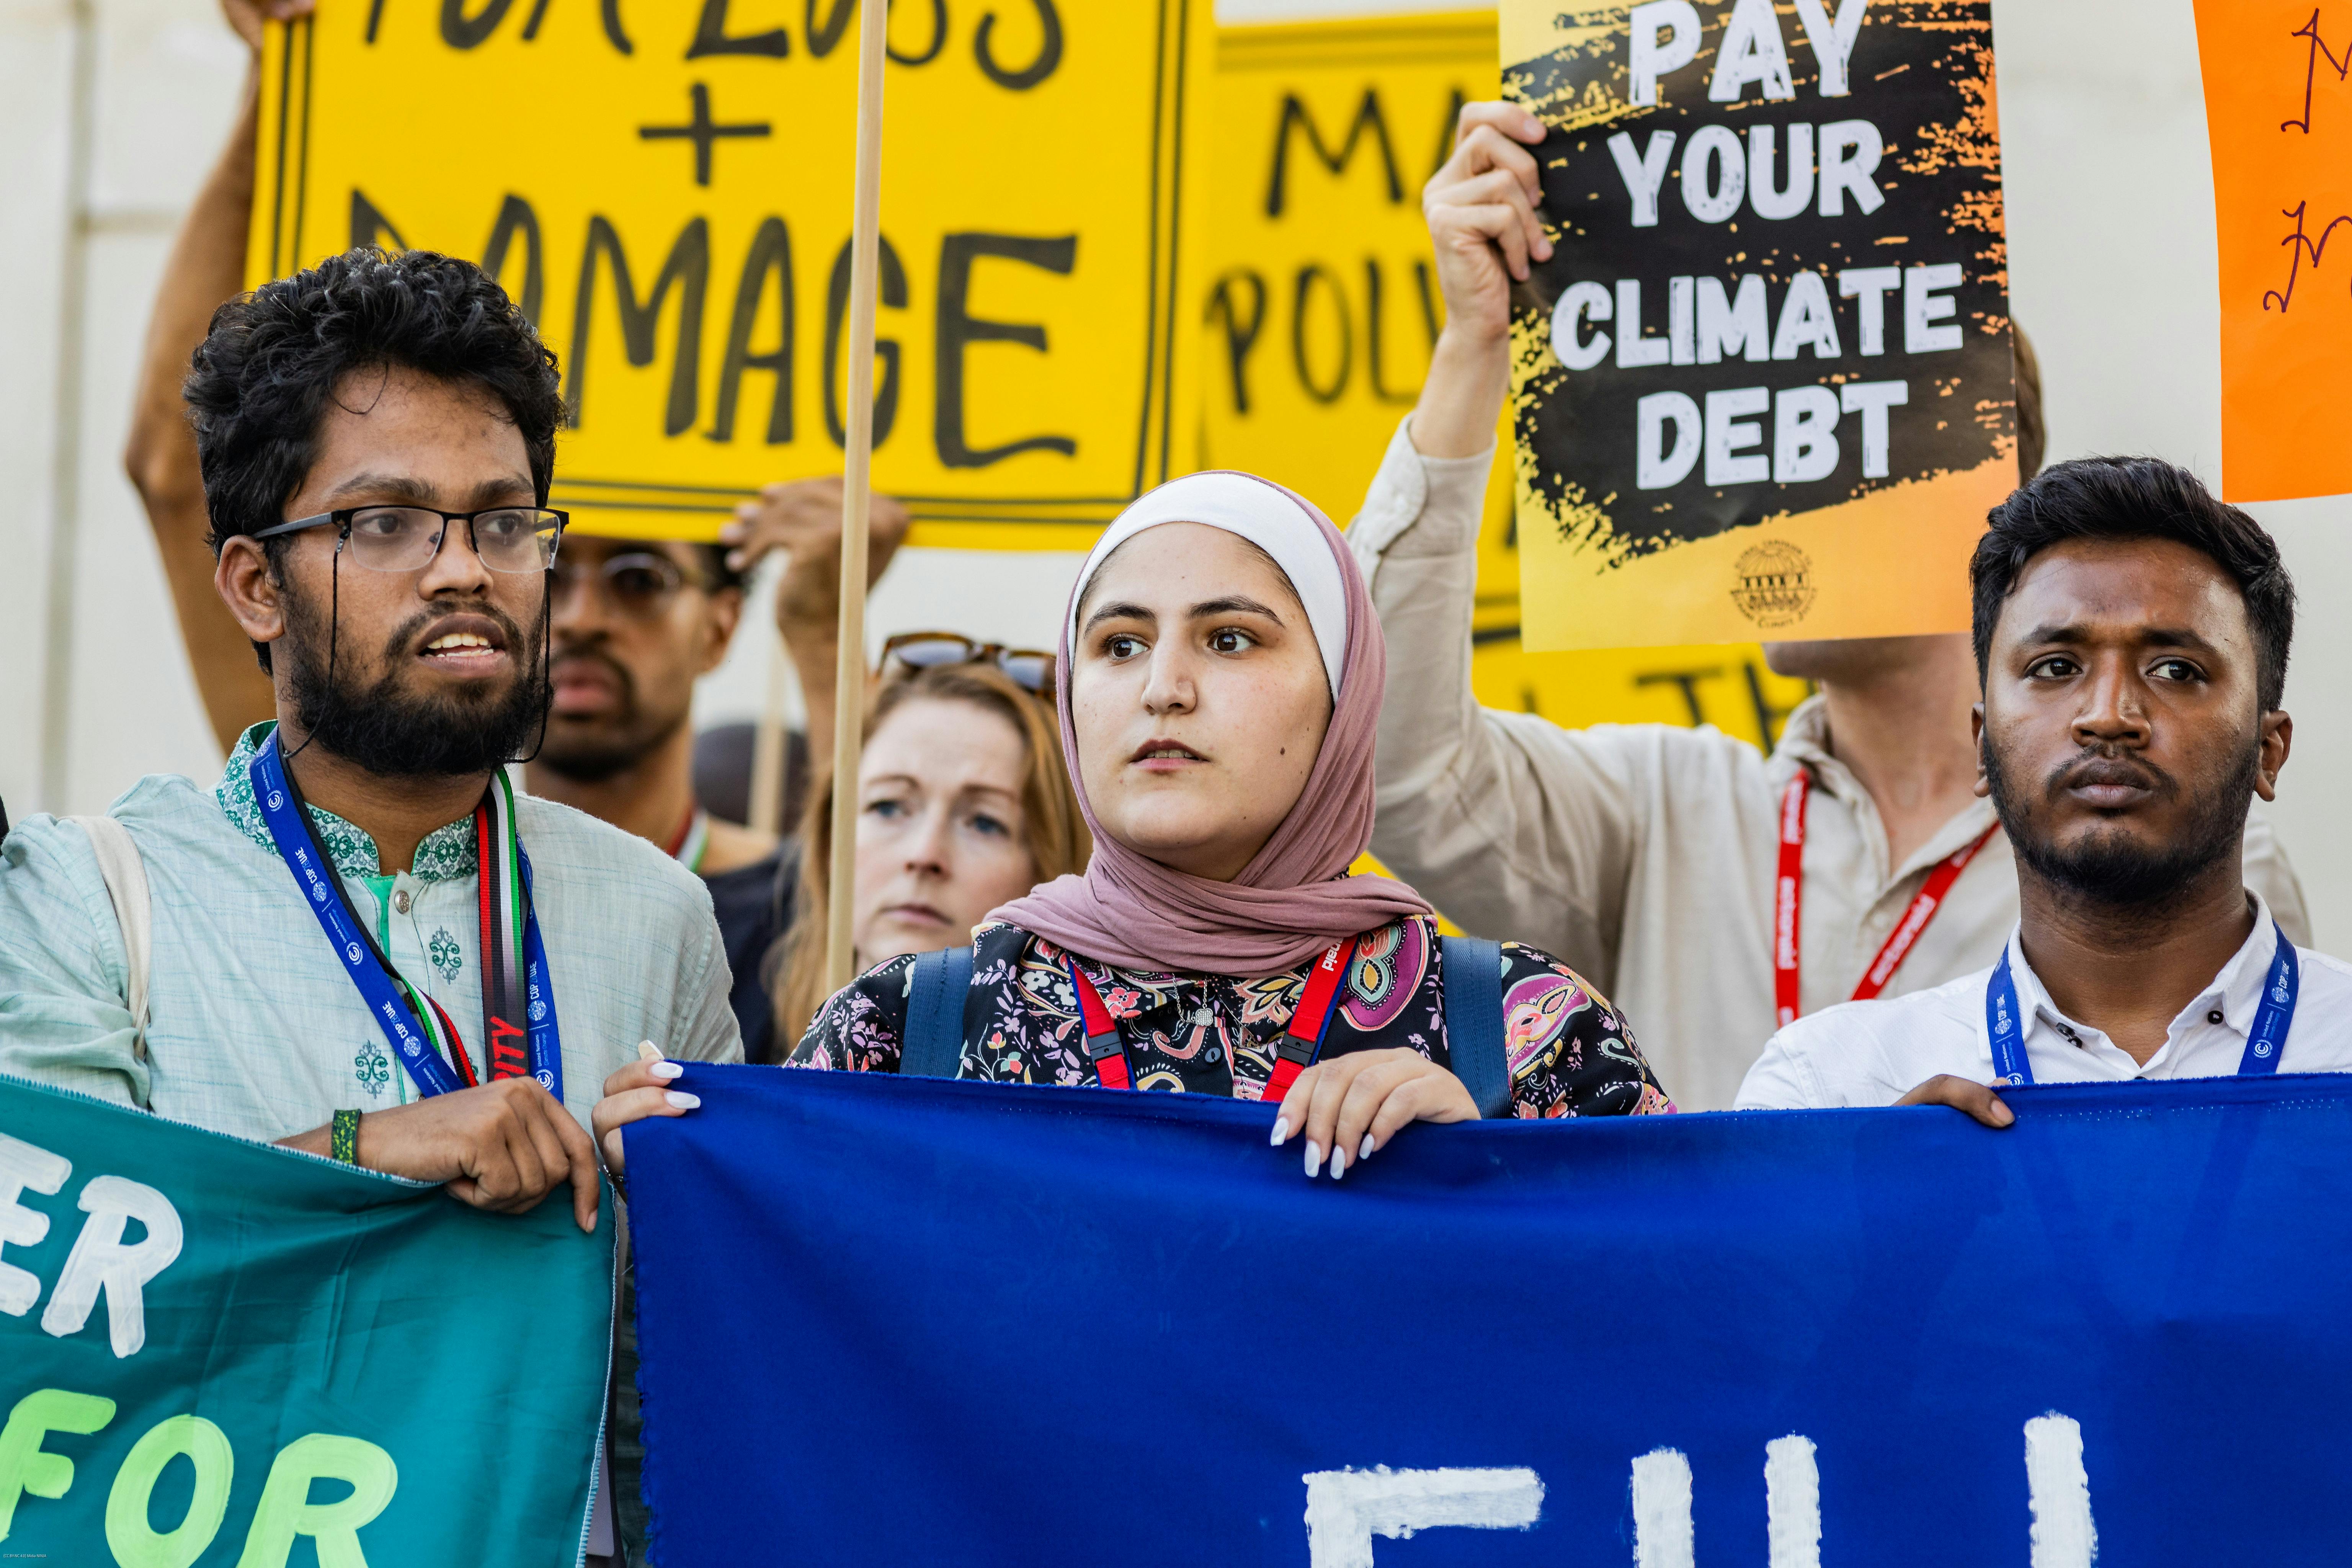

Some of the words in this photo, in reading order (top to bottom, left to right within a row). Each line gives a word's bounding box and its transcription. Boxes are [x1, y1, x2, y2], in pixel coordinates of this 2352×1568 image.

[1629, 0, 1869, 107] PAY
[1607, 119, 1885, 227] YOUR
[349, 188, 1080, 470] MAGE
[1550, 263, 1963, 371] CLIMATE
[1637, 380, 1909, 490] DEBT
[1321, 938, 1344, 972] naid
[382, 1001, 408, 1039] COP28UAE
[0, 1130, 184, 1359] ER
[0, 1388, 398, 1568] FOR
